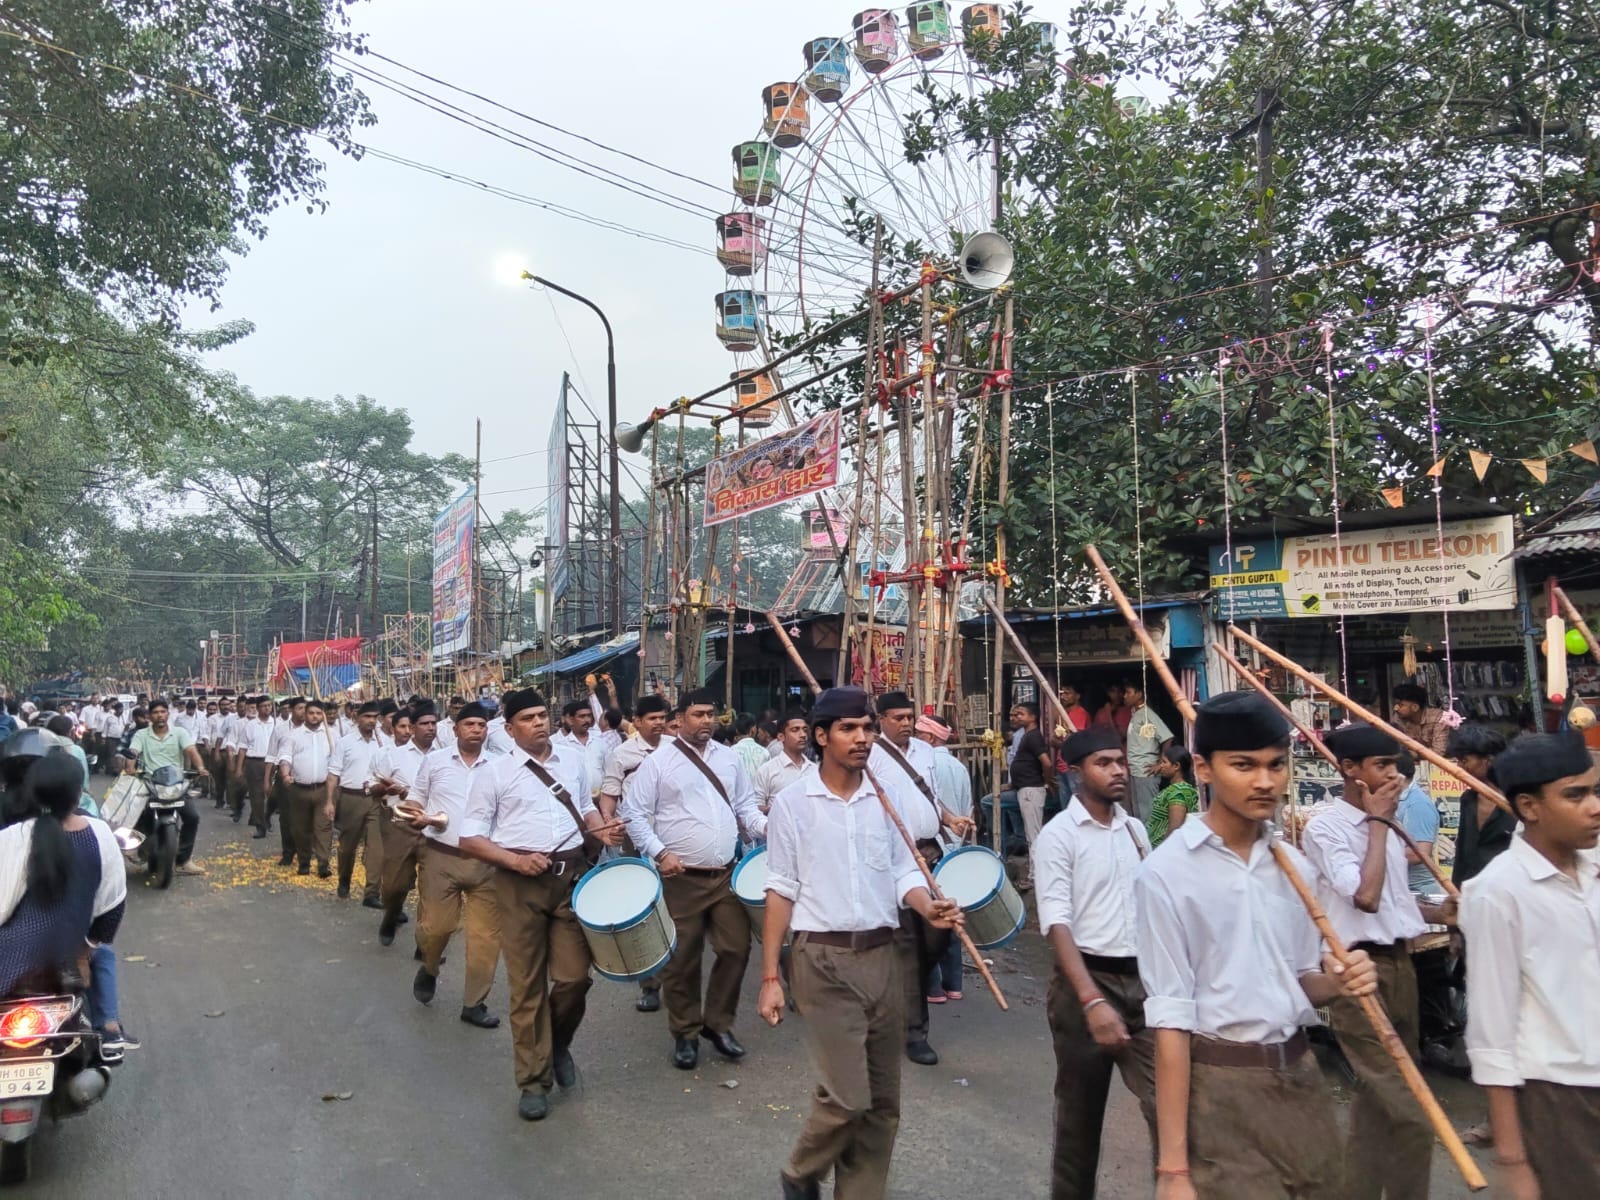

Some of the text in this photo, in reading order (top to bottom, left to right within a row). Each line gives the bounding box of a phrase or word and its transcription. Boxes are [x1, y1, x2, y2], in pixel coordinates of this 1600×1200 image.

[714, 463, 826, 513] निकास द्वार
[1297, 533, 1498, 568] PINTU TELECOM
[1222, 573, 1275, 585] PNTU GUPTA
[1318, 571, 1328, 579] All
[1361, 567, 1401, 576] Repairing
[1356, 580, 1364, 588] of
[1366, 579, 1395, 588] Display,
[1396, 577, 1423, 586] Touch,
[1350, 588, 1430, 599] Headphone, Temperd,
[1357, 600, 1378, 608] Cover
[1394, 598, 1429, 607] Available
[14, 1069, 25, 1078] 10
[29, 1067, 42, 1076] BC
[0, 1080, 46, 1094] 942
